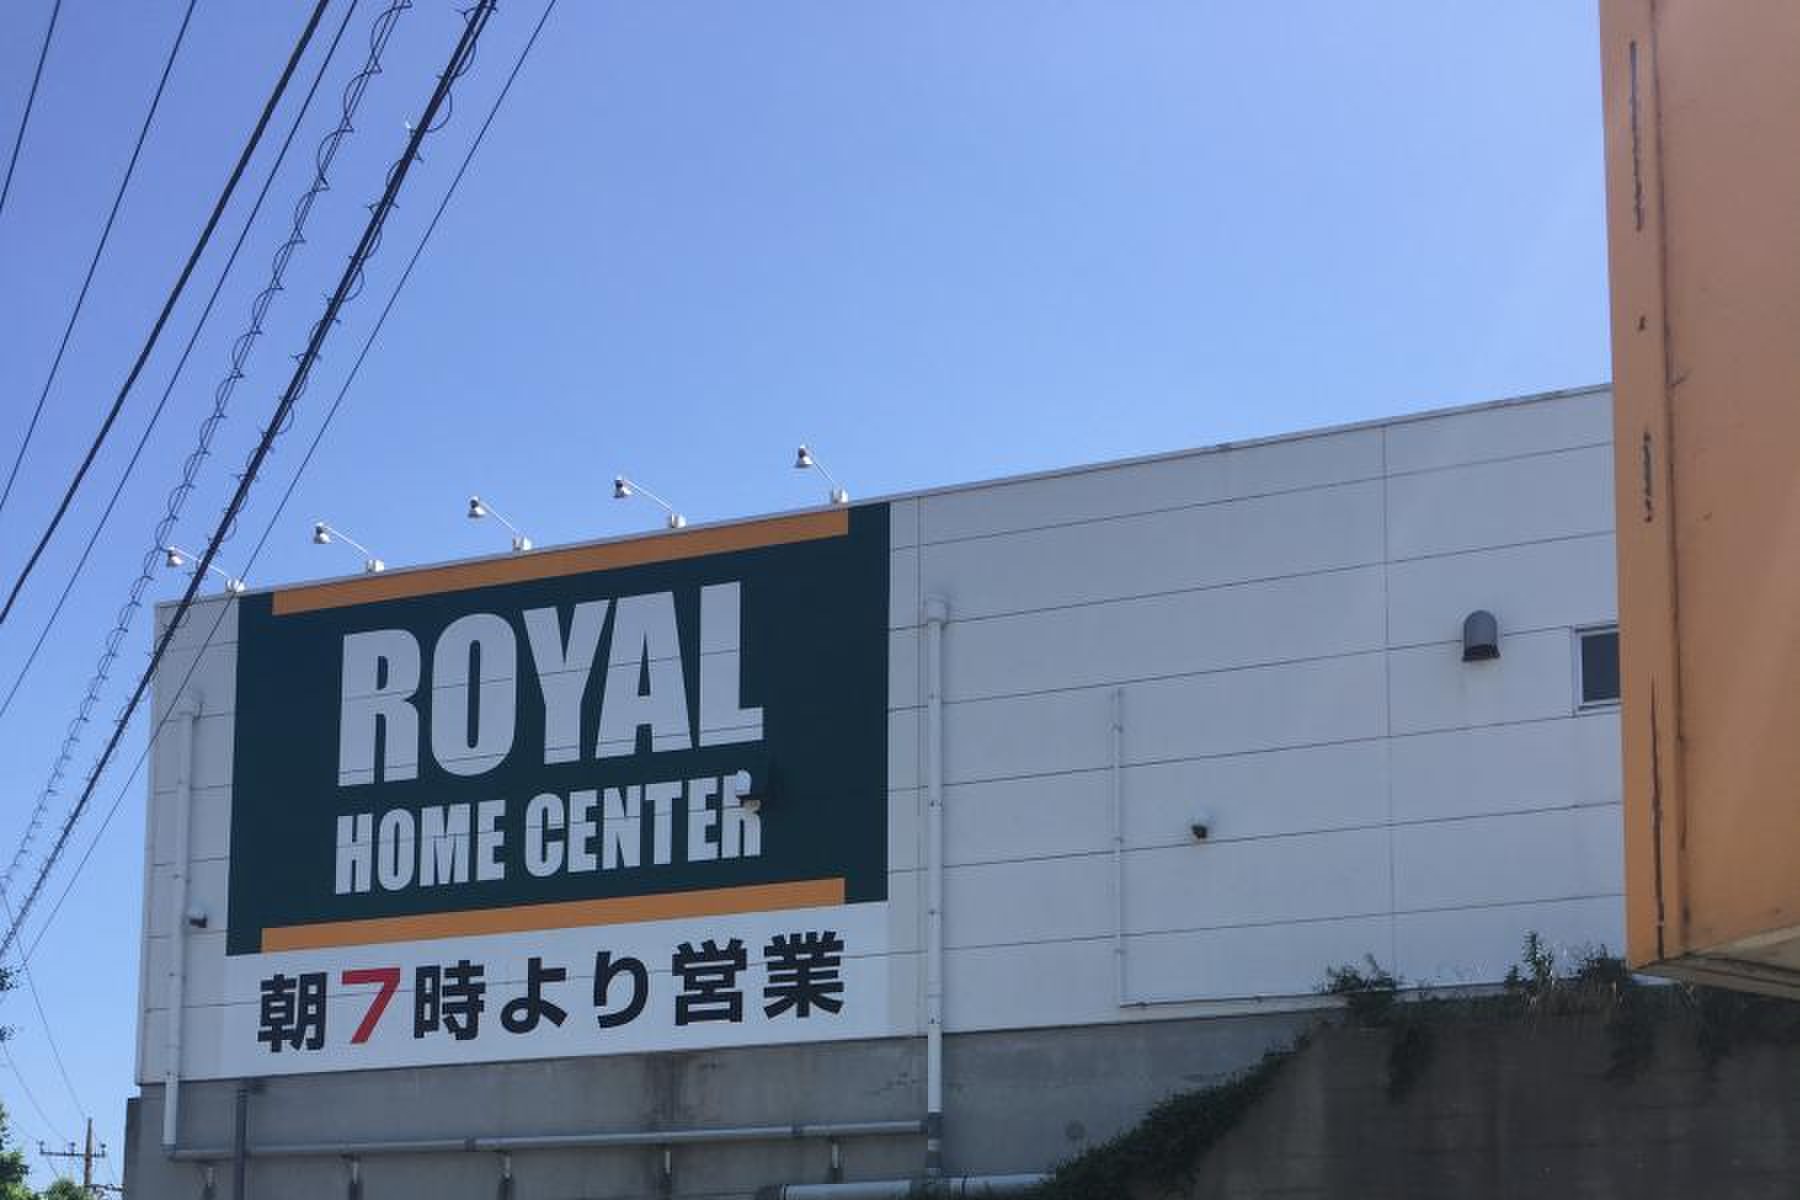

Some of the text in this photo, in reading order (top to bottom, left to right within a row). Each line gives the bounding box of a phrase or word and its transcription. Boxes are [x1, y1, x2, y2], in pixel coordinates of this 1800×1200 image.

[338, 581, 763, 787] ROYAL
[335, 772, 762, 896] HOME CENTER
[257, 931, 845, 1053] 朝7時より営業
